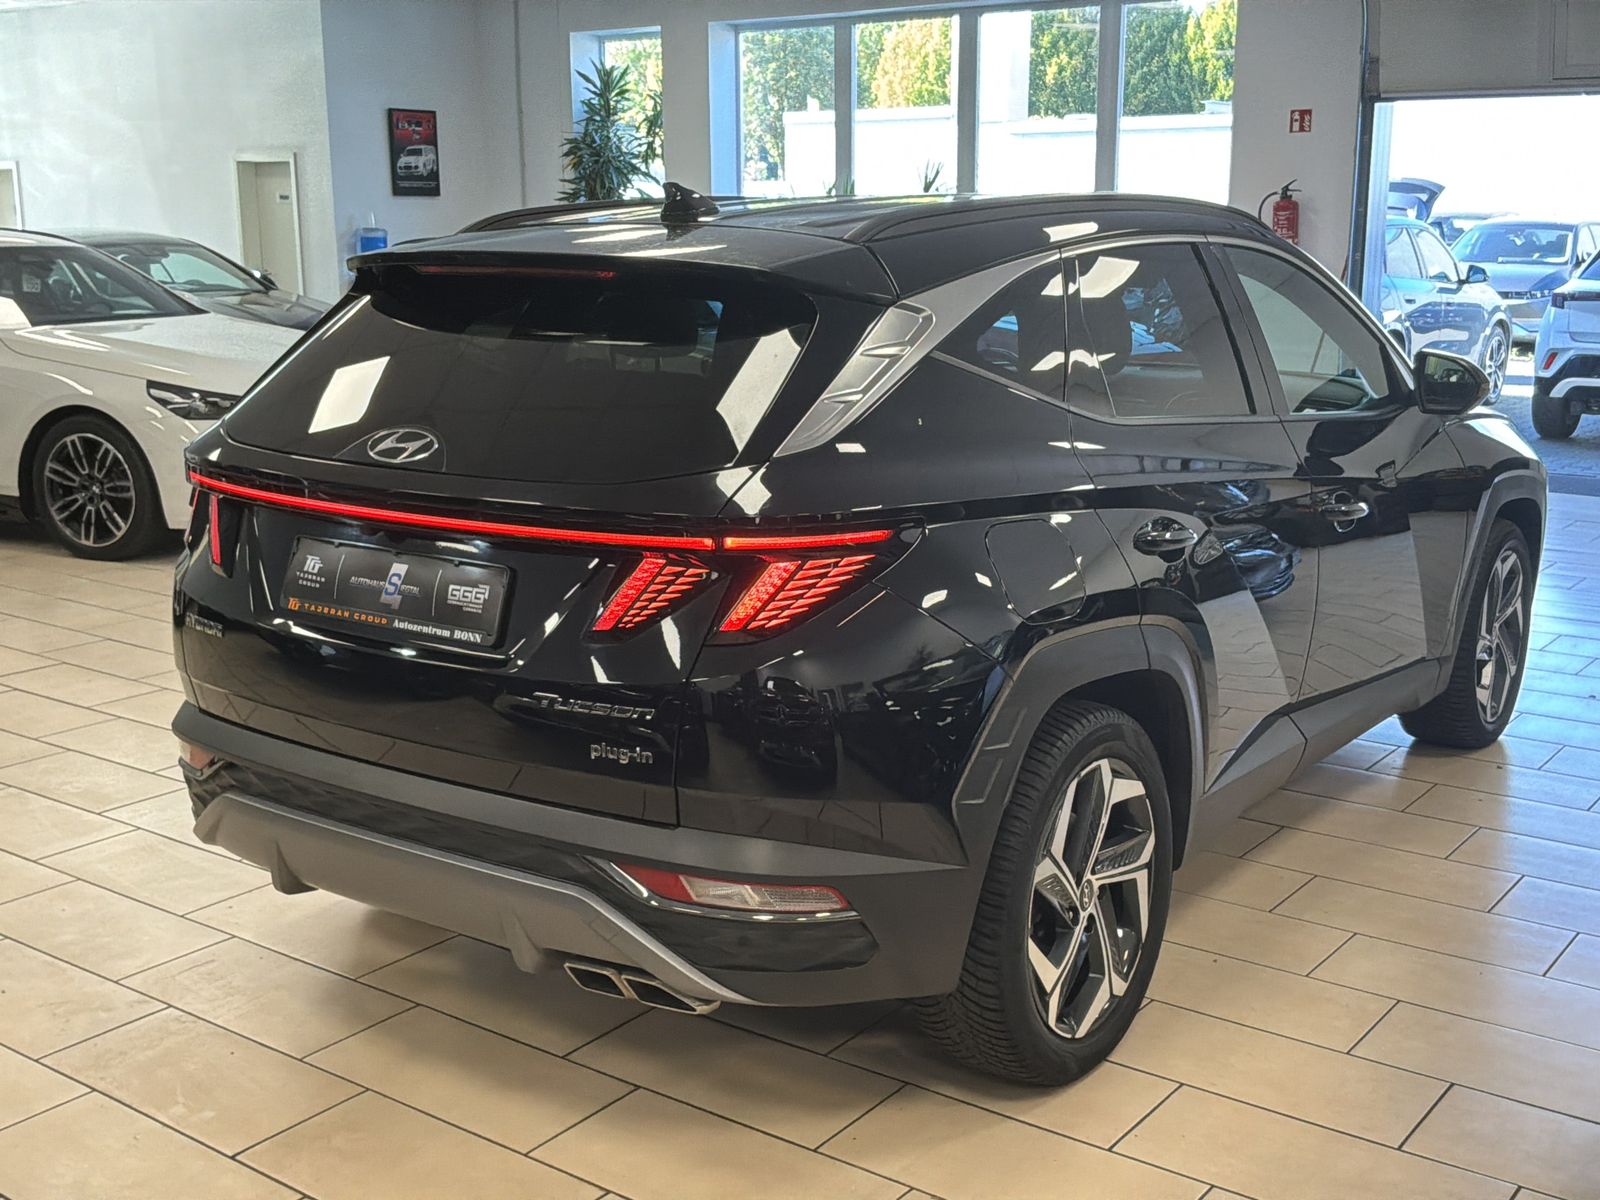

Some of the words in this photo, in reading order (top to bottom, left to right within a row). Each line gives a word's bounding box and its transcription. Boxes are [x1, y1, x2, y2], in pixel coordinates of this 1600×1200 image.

[353, 612, 388, 625] GROUP
[392, 619, 451, 638] Autozentrum
[453, 629, 483, 643] BONN
[590, 742, 654, 764] plug-in
